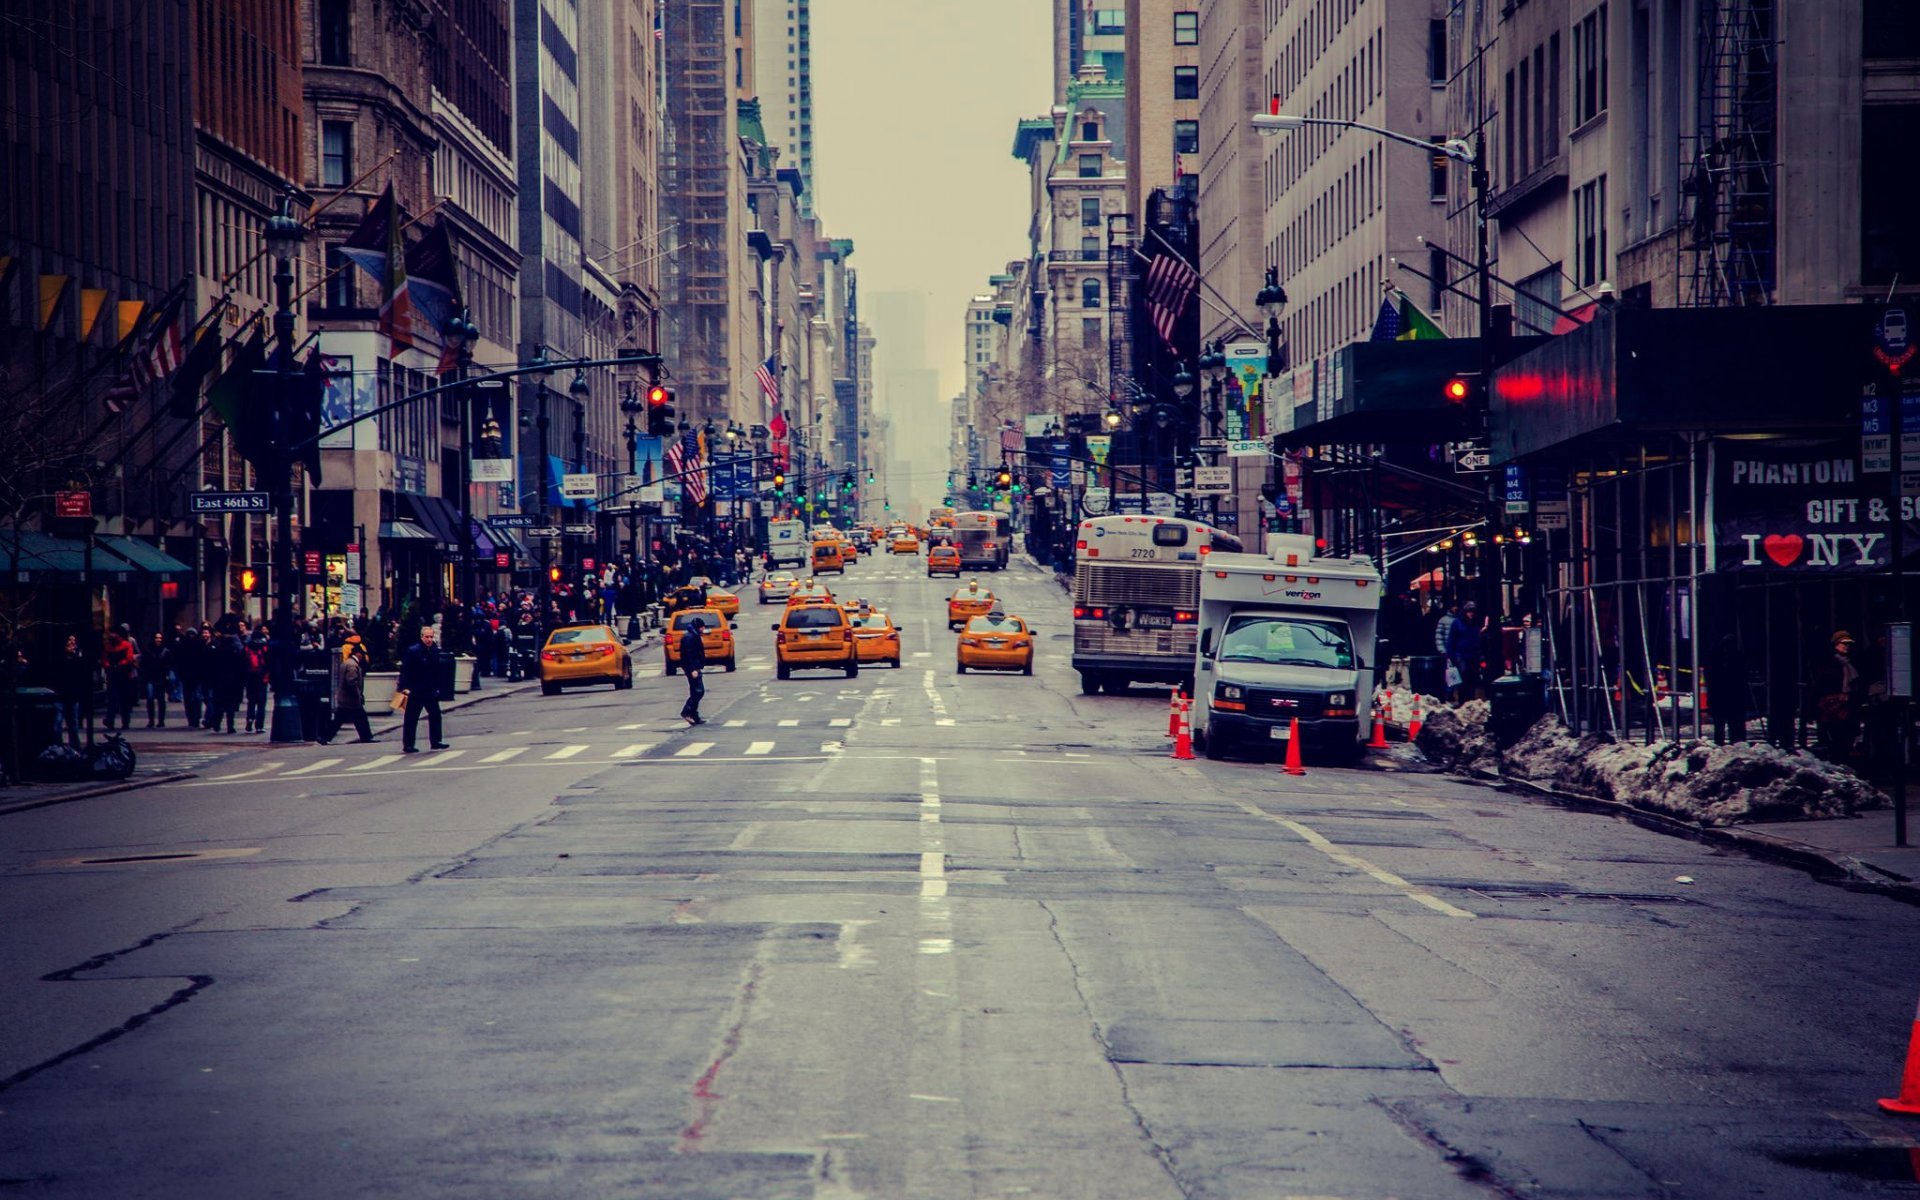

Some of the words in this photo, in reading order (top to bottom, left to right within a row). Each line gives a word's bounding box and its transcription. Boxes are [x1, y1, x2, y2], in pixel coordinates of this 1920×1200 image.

[1863, 382, 1876, 396] M2
[1863, 400, 1878, 413] M3
[1863, 419, 1879, 432] M5
[1466, 457, 1485, 465] ONE
[1733, 459, 1855, 484] PHANTOM
[1507, 479, 1519, 488] M4
[196, 498, 221, 508] East
[224, 497, 249, 508] 46th
[251, 496, 264, 507] St
[1807, 498, 1859, 524] GIFT
[1868, 498, 1890, 522] &
[1131, 548, 1155, 558] 2720
[1741, 534, 1762, 566] I
[1285, 590, 1321, 599] verizon
